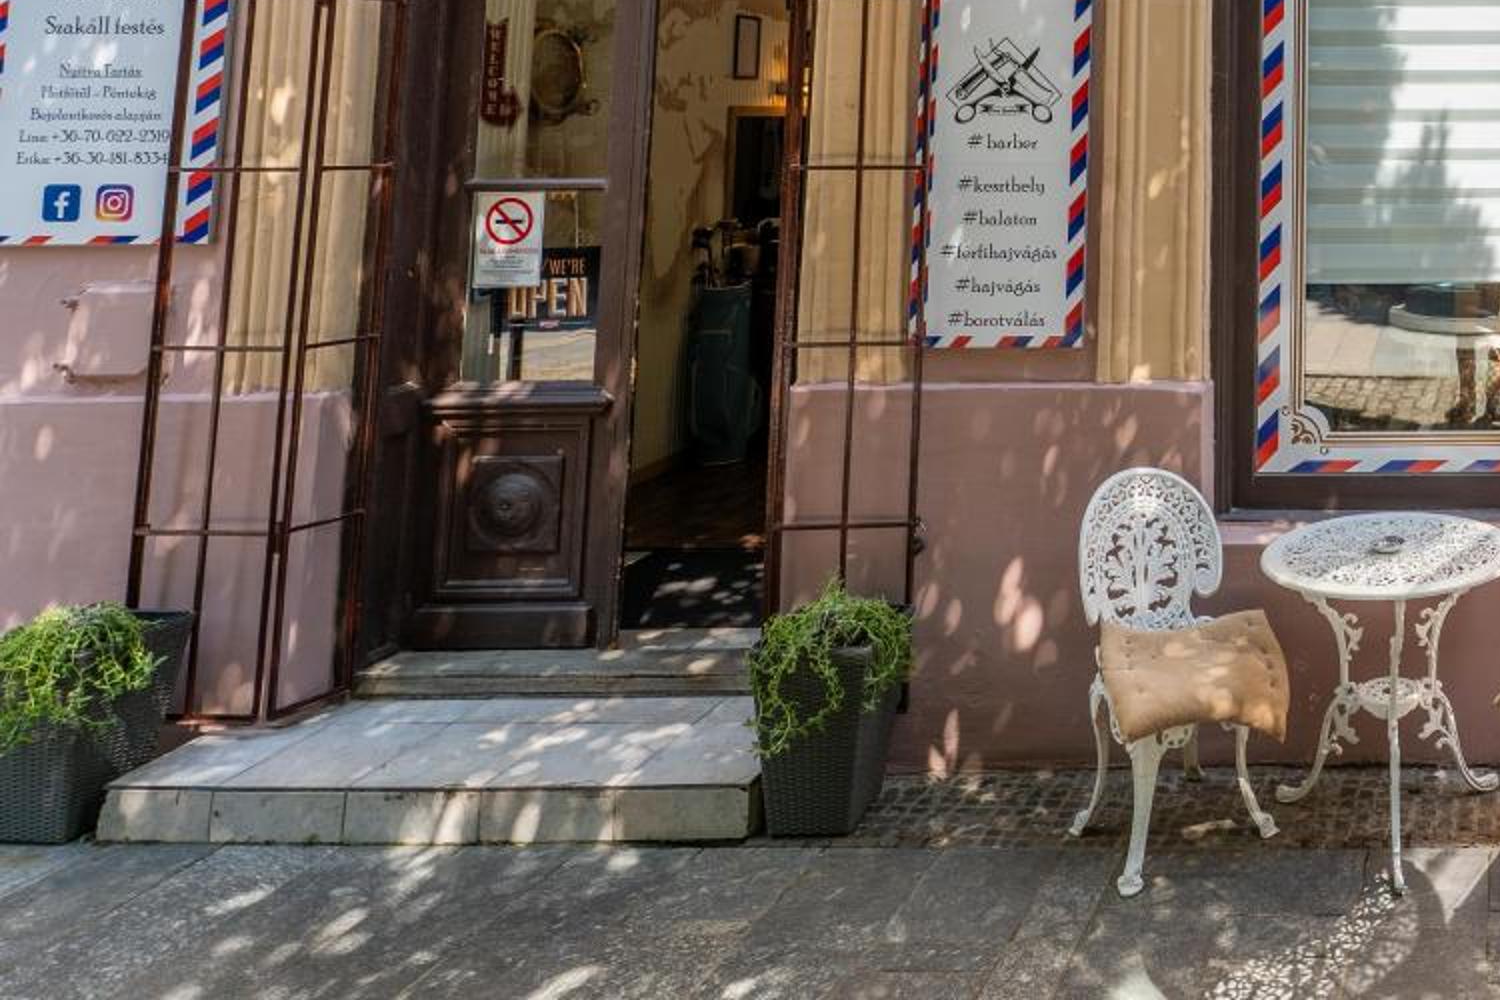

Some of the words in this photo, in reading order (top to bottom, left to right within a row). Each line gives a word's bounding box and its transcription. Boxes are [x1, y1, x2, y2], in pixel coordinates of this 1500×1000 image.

[45, 16, 109, 35] Szakáll
[115, 16, 165, 35] festés
[986, 133, 1038, 149] barber
[959, 175, 1045, 195] #keszthely
[962, 209, 1037, 225] #balaton
[955, 276, 1041, 297] #hajvágás
[508, 278, 587, 318] OPEN
[947, 308, 1045, 327] #borotválás
